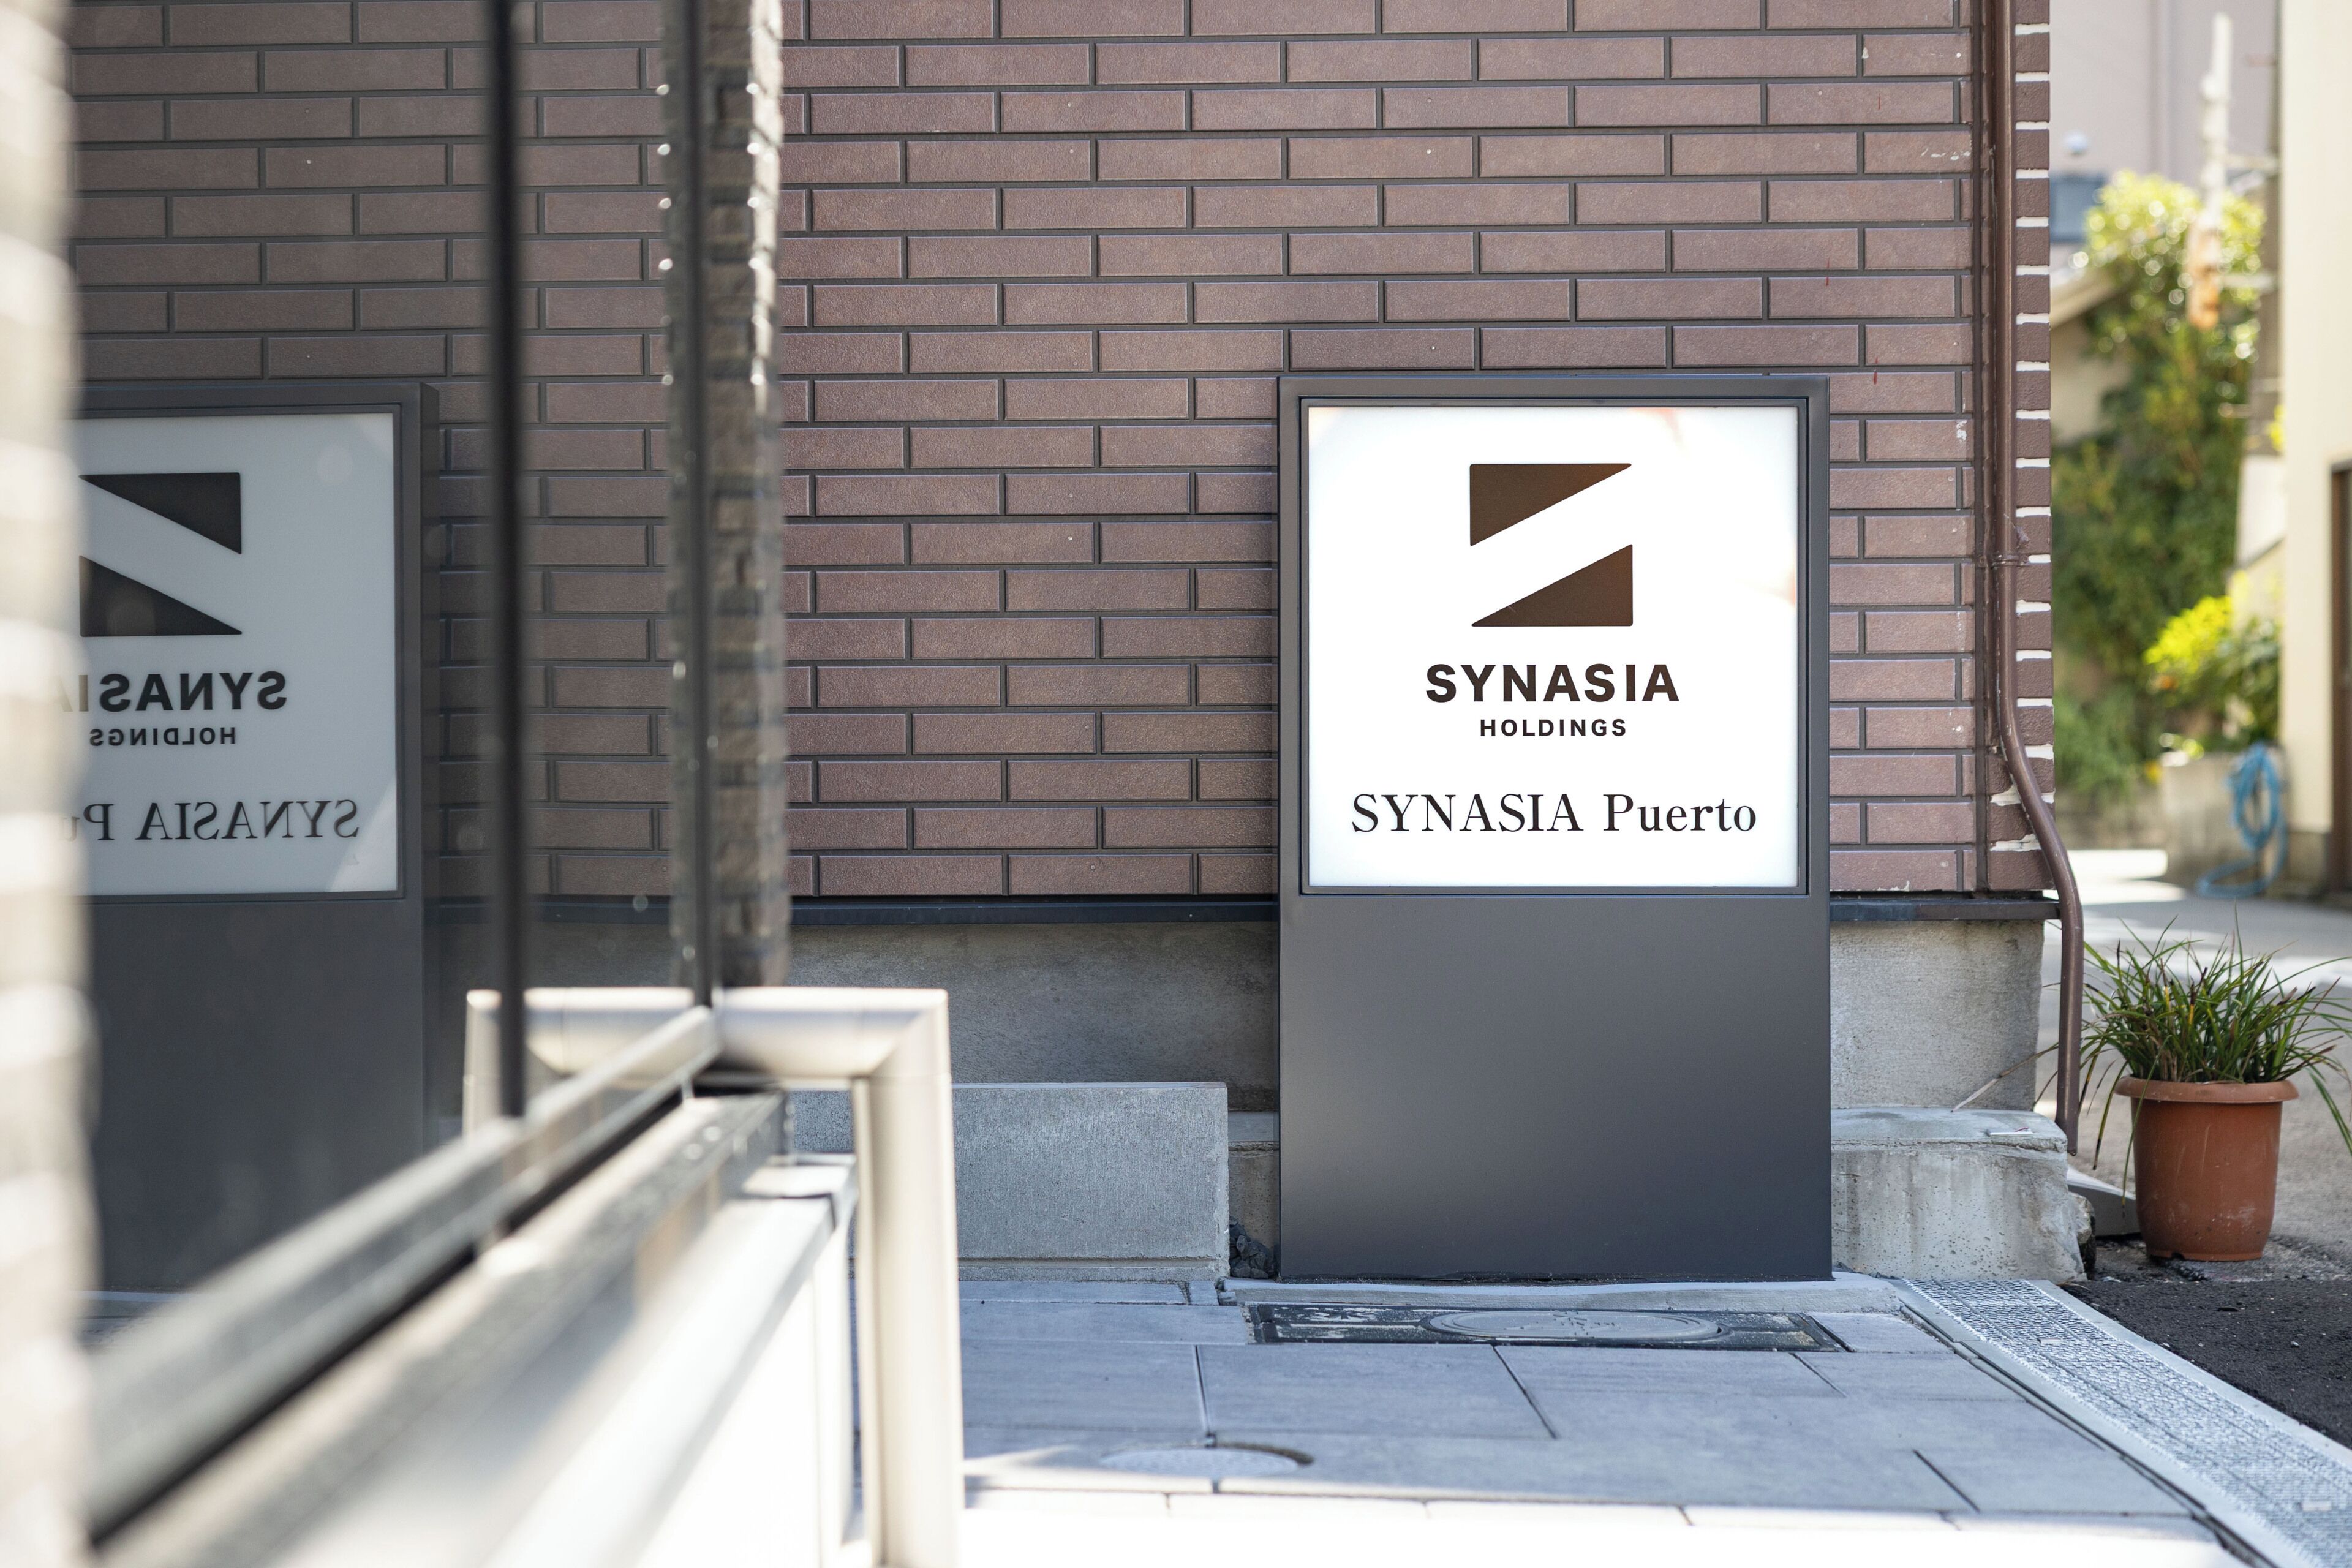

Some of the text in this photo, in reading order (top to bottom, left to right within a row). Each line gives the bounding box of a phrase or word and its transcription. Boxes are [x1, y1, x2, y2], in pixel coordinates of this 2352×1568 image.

[1426, 663, 1679, 703] SYNASIA
[1480, 718, 1626, 737] HOLDINGS
[1352, 793, 1757, 832] SYNASIA Puerto
